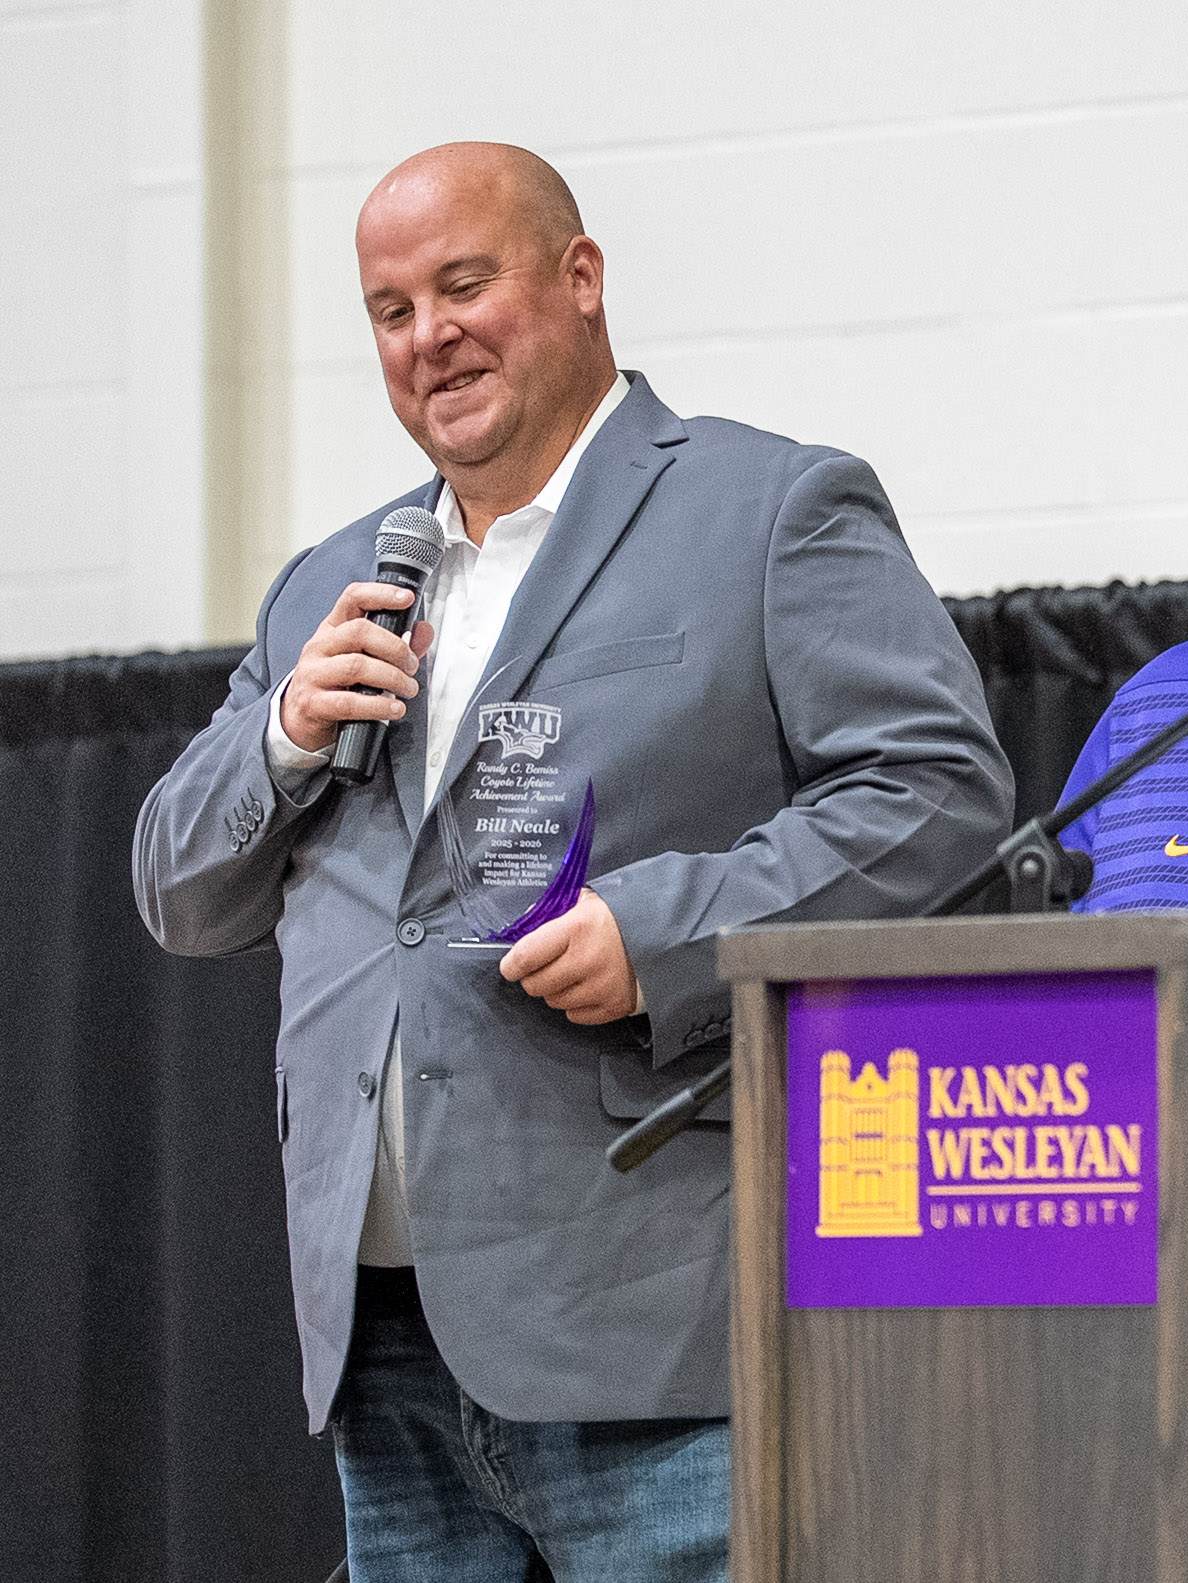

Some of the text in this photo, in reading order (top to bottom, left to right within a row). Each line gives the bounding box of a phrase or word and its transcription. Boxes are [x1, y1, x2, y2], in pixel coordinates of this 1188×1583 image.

[479, 708, 561, 744] KWU
[476, 761, 559, 775] Randy C. Bemiss
[480, 775, 556, 790] Coyote Lifetime
[469, 788, 566, 802] Achievement Award
[496, 805, 538, 815] Presented to
[474, 818, 560, 835] Bill Neale
[491, 839, 512, 848] 2025
[520, 839, 542, 848] 2026
[484, 851, 547, 861] For committing to
[493, 861, 519, 869] making
[526, 861, 552, 871] lifelong
[509, 869, 520, 877] for
[521, 869, 546, 878] Kansas
[482, 878, 548, 887] Wesleyan Athletics
[928, 1062, 1090, 1118] KANSAS
[927, 1123, 1142, 1180] WESLEYAN
[929, 1199, 1139, 1230] UNIVERSITY
